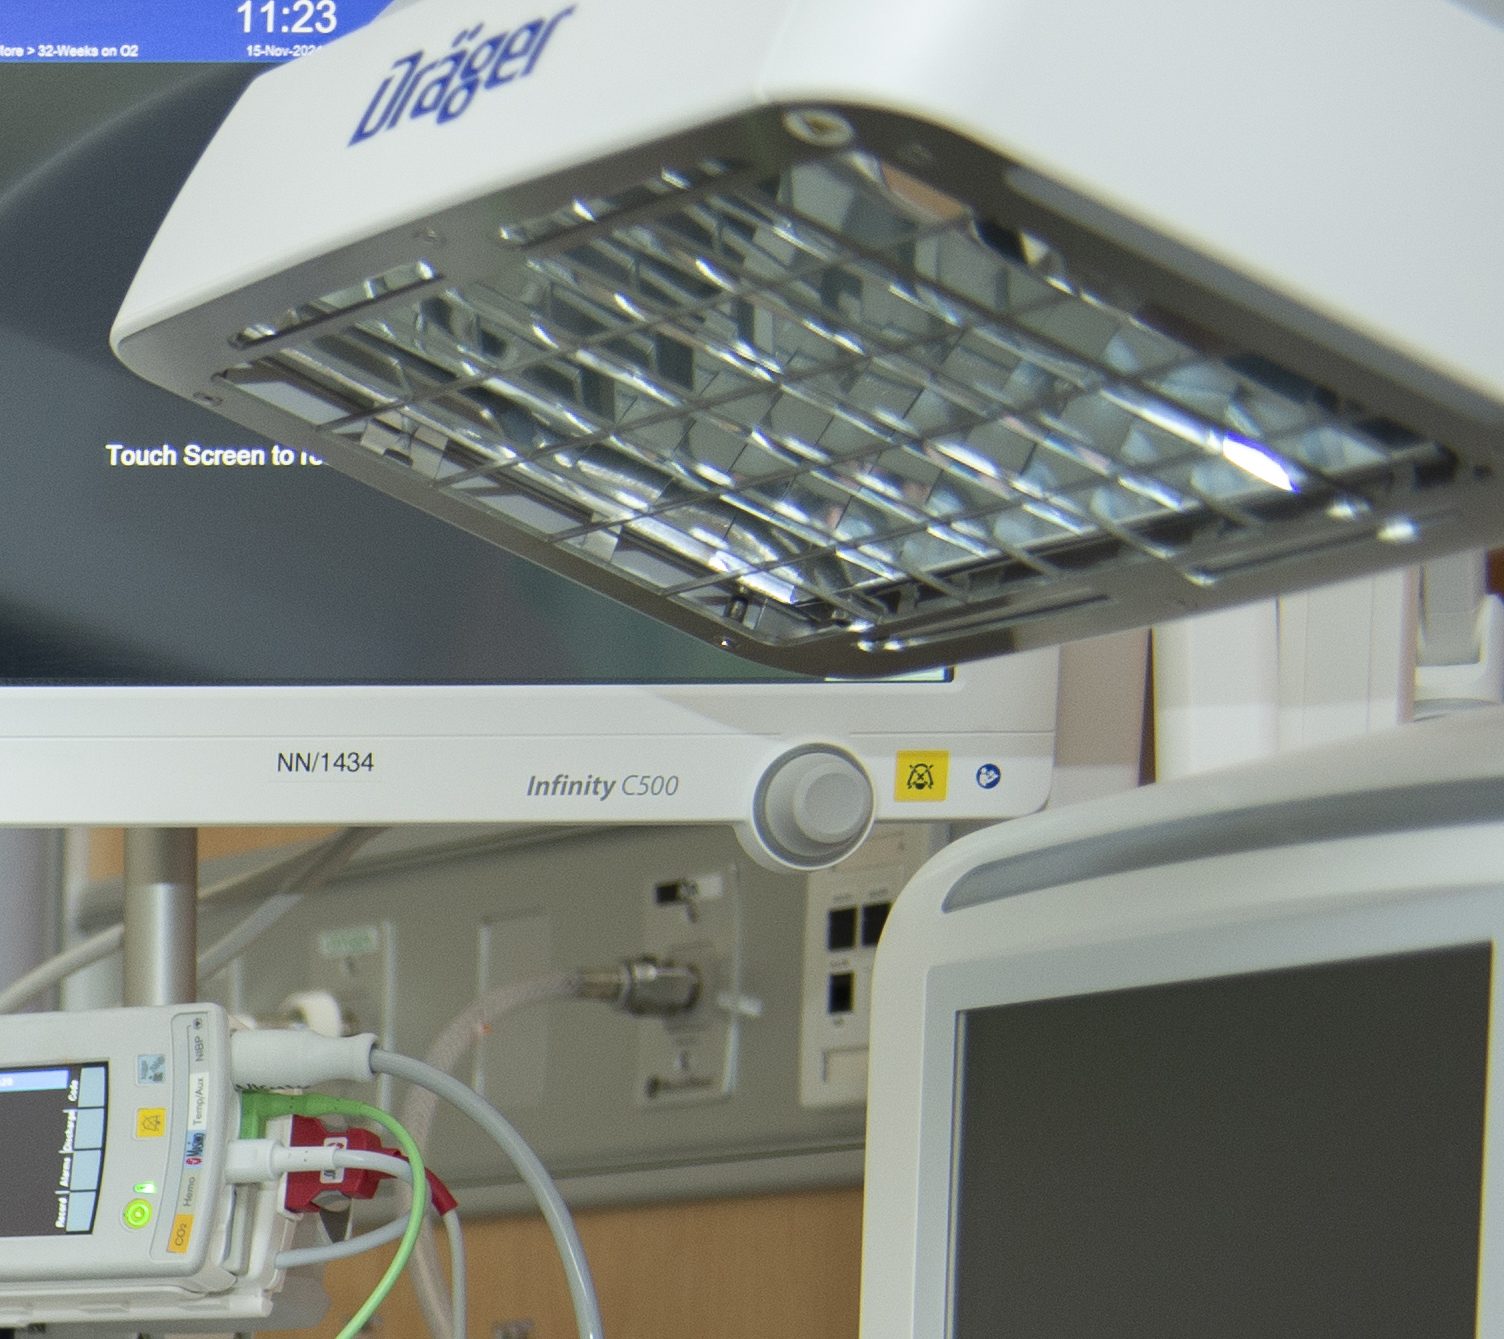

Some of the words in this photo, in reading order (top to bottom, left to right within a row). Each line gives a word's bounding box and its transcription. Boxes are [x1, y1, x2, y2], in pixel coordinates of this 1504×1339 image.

[237, 0, 338, 34] 11:23
[37, 44, 100, 57] 32-Weeks
[101, 47, 118, 57] on
[348, 4, 576, 147] Dräger
[105, 444, 177, 466] Touch
[183, 444, 265, 466] Screen
[271, 444, 295, 466] to
[277, 751, 375, 773] NN/1434
[526, 774, 617, 802] Infinity
[621, 774, 680, 797] C500
[194, 1035, 205, 1062] NIBP
[67, 1079, 80, 1102] Code
[193, 1078, 205, 1126] Temp/Aux
[63, 1111, 77, 1150] Discharge
[59, 1156, 72, 1188] Alarms
[183, 1176, 196, 1208] Hemo
[55, 1196, 69, 1229] Record
